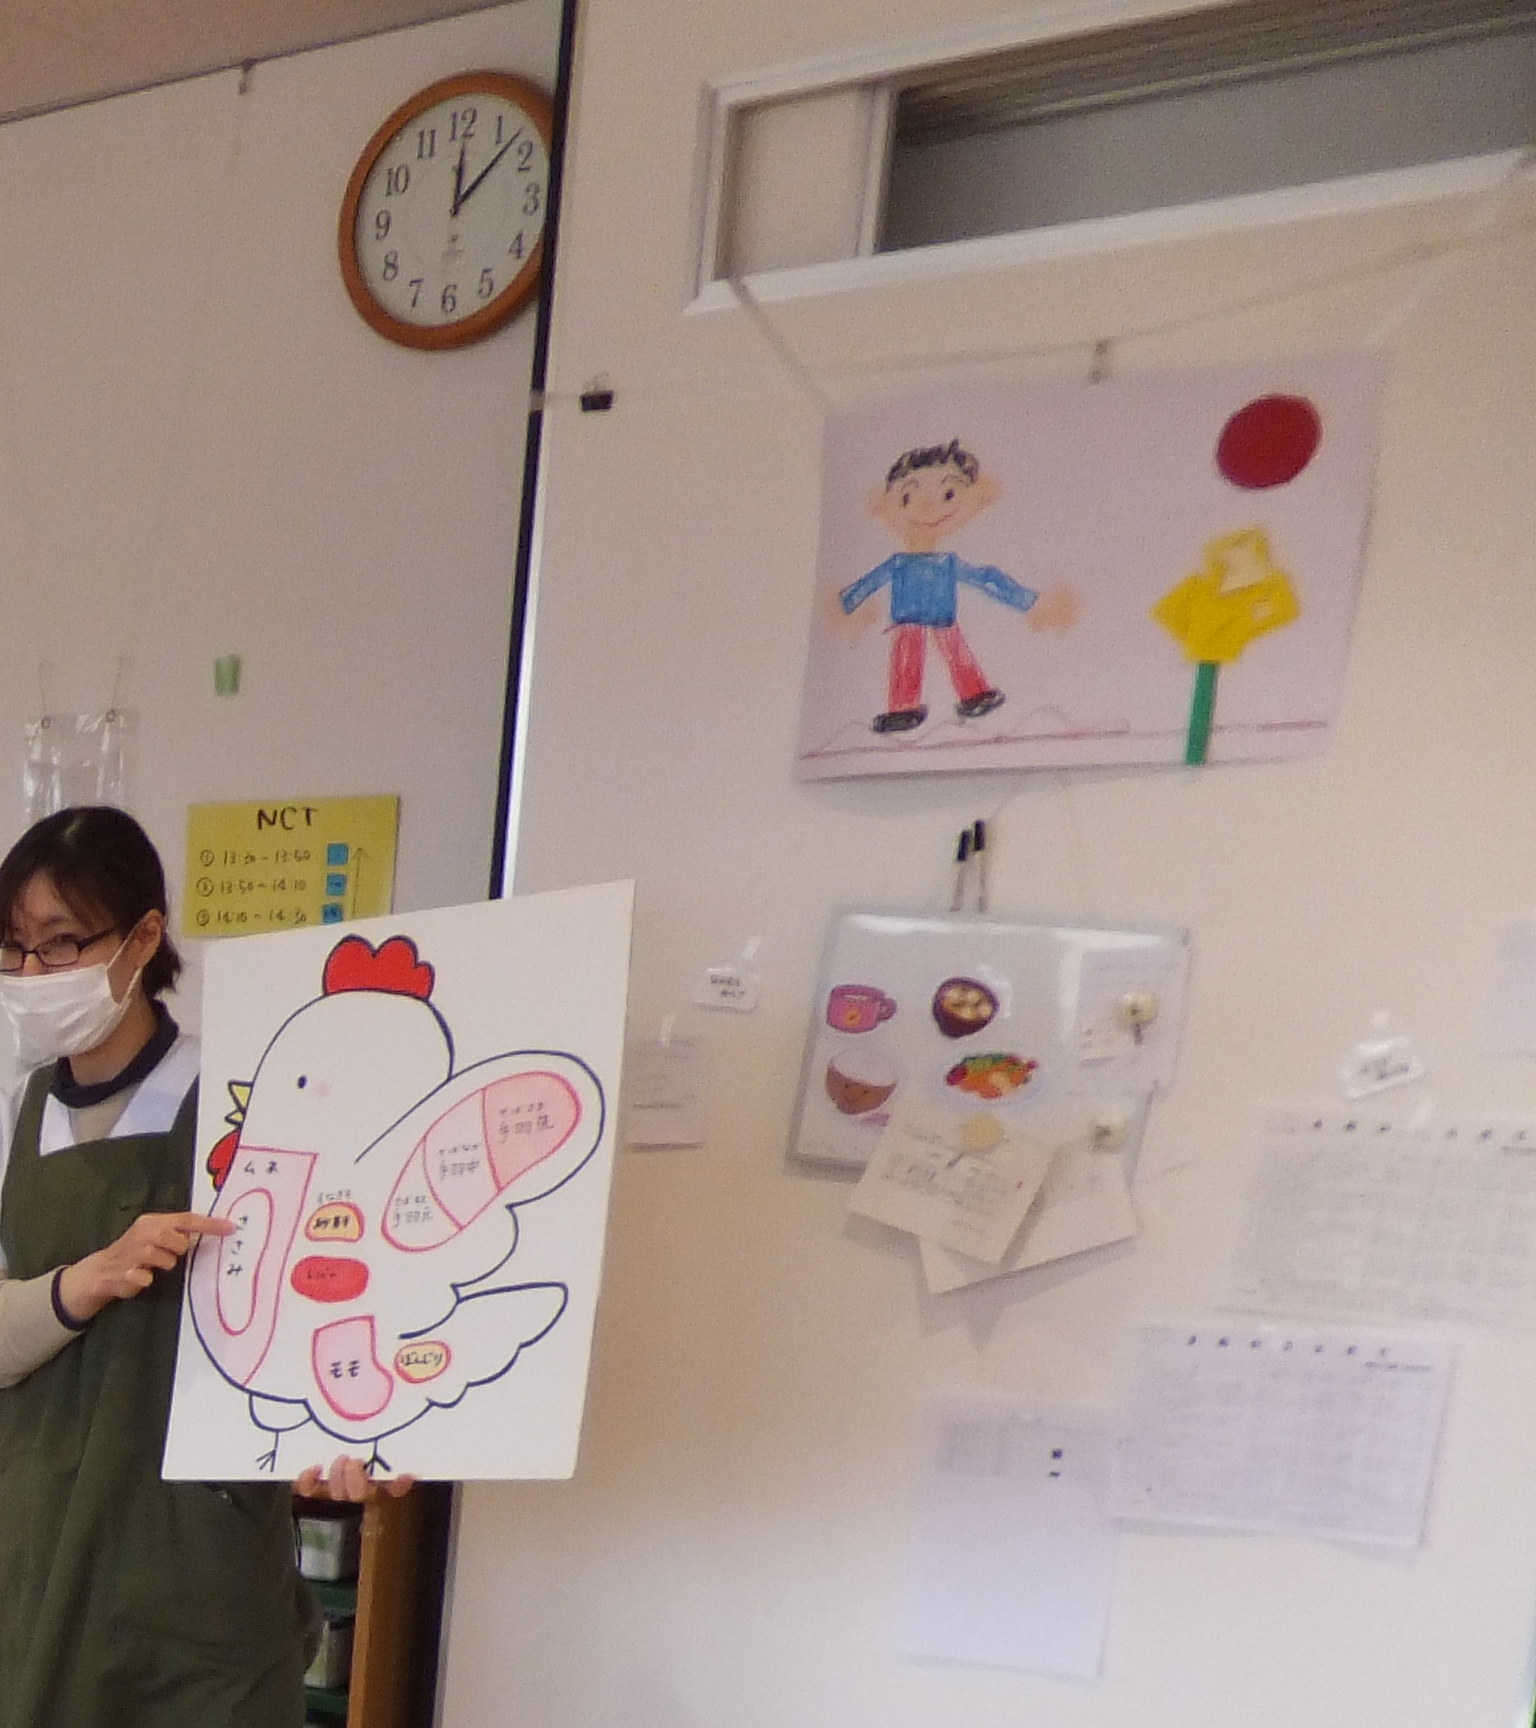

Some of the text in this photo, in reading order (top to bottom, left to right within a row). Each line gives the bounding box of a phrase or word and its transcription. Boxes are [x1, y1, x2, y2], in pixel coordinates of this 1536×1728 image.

[449, 108, 477, 141] 12
[494, 115, 504, 144] 1
[418, 130, 437, 158] 11
[518, 141, 534, 172] 2
[385, 166, 410, 197] 10
[523, 184, 540, 215] 3
[376, 210, 391, 241] 9
[508, 232, 524, 260] 4
[383, 251, 399, 281] 8
[409, 279, 424, 309] 7
[478, 268, 494, 299] 5
[442, 284, 457, 314] 6
[257, 807, 319, 831] NCT
[244, 1159, 278, 1175] ムネ
[329, 1360, 361, 1379] モモ
